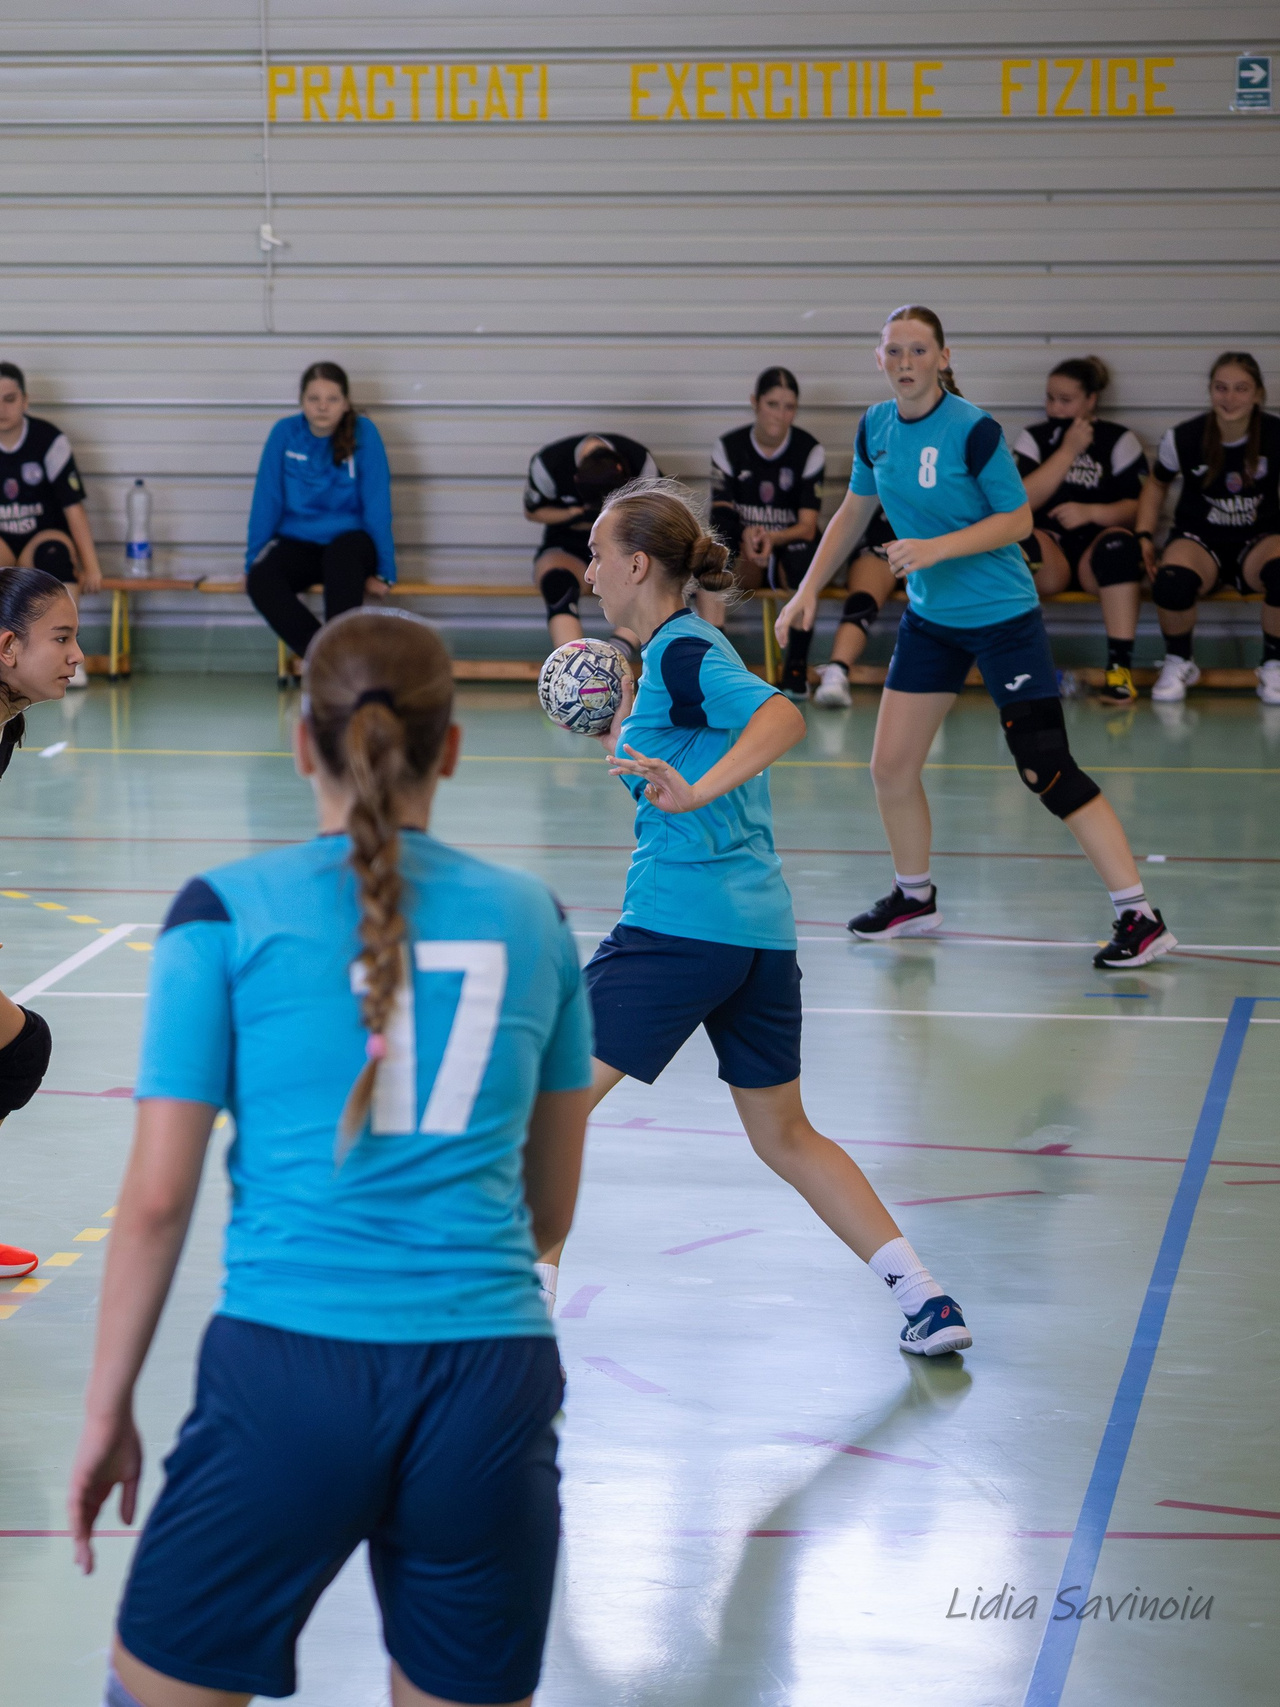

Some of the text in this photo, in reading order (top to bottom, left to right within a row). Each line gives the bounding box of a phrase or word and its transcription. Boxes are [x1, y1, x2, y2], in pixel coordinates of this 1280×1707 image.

[268, 58, 1175, 121] PRACTICATI EXERCITIILE FIZICE
[918, 446, 939, 488] 8
[349, 940, 508, 1135] 17
